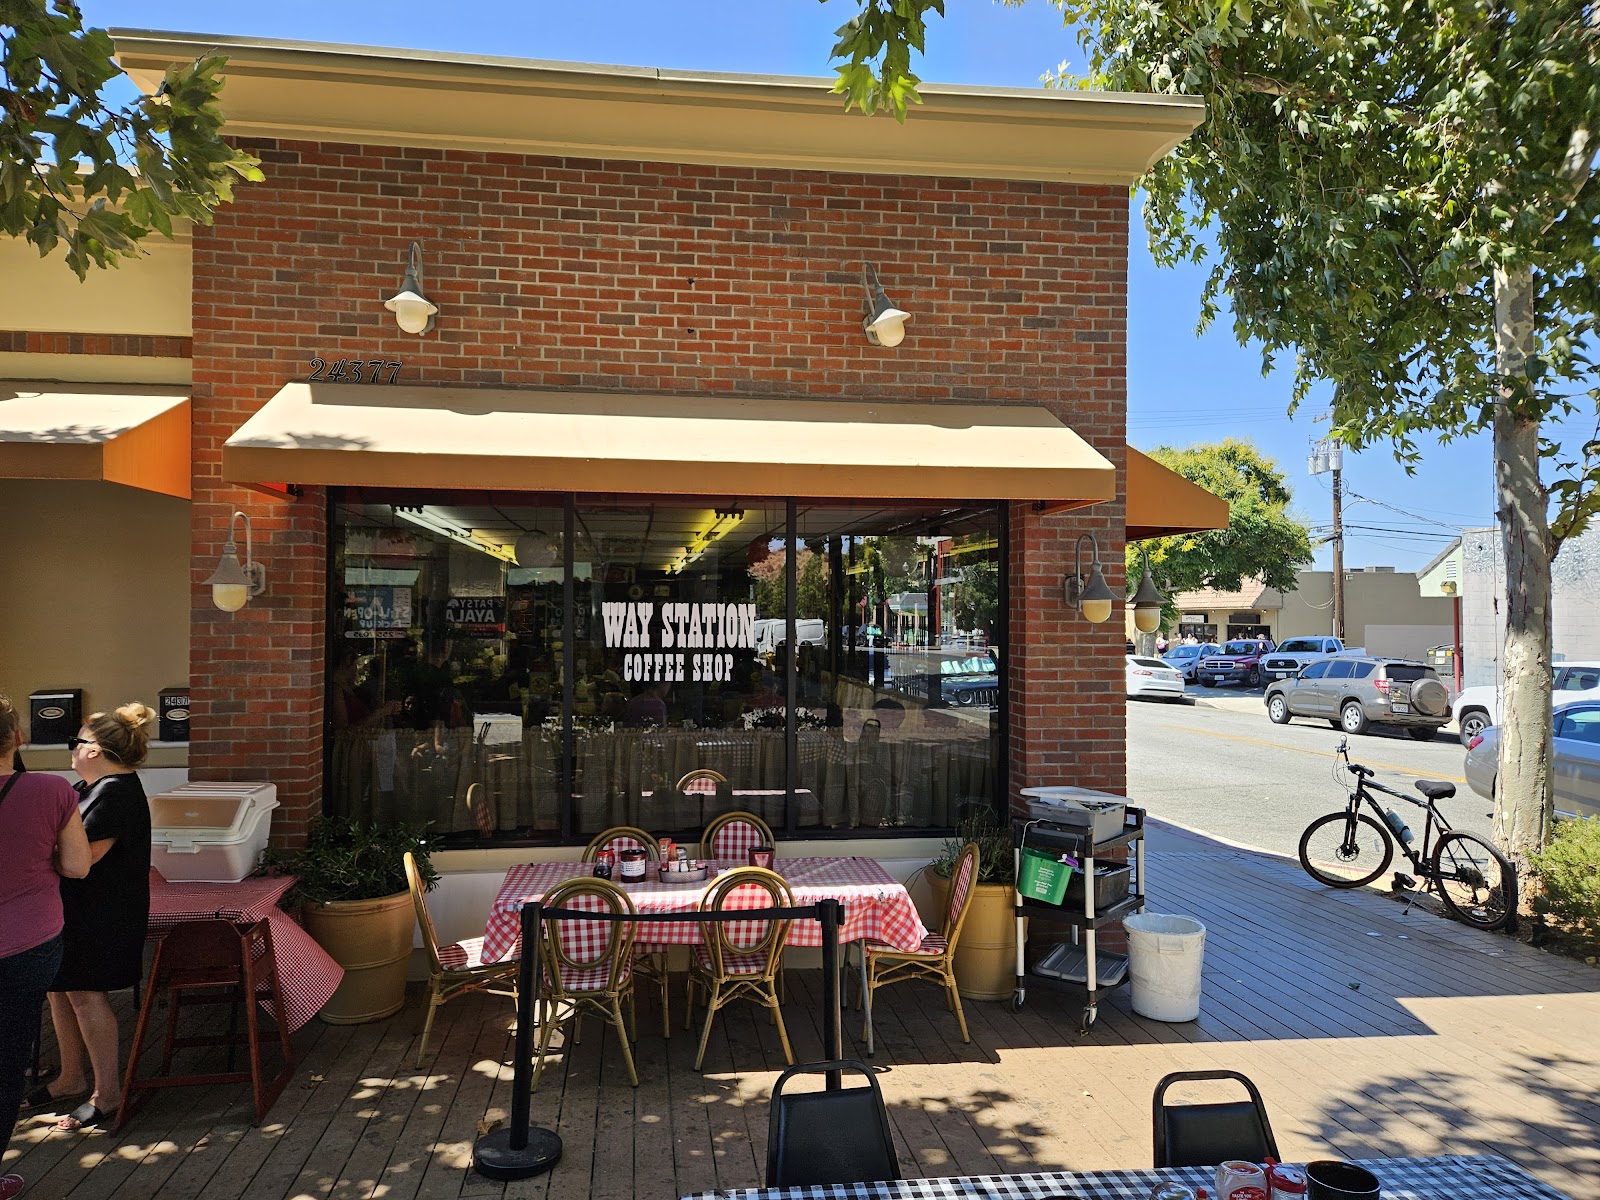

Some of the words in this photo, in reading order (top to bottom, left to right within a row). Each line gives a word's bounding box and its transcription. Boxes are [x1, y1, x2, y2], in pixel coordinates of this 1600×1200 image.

[308, 357, 403, 385] 24377
[602, 602, 653, 648] WAY
[662, 602, 756, 648] STATION
[623, 653, 685, 682] COFFEE
[692, 653, 734, 682] SHOP
